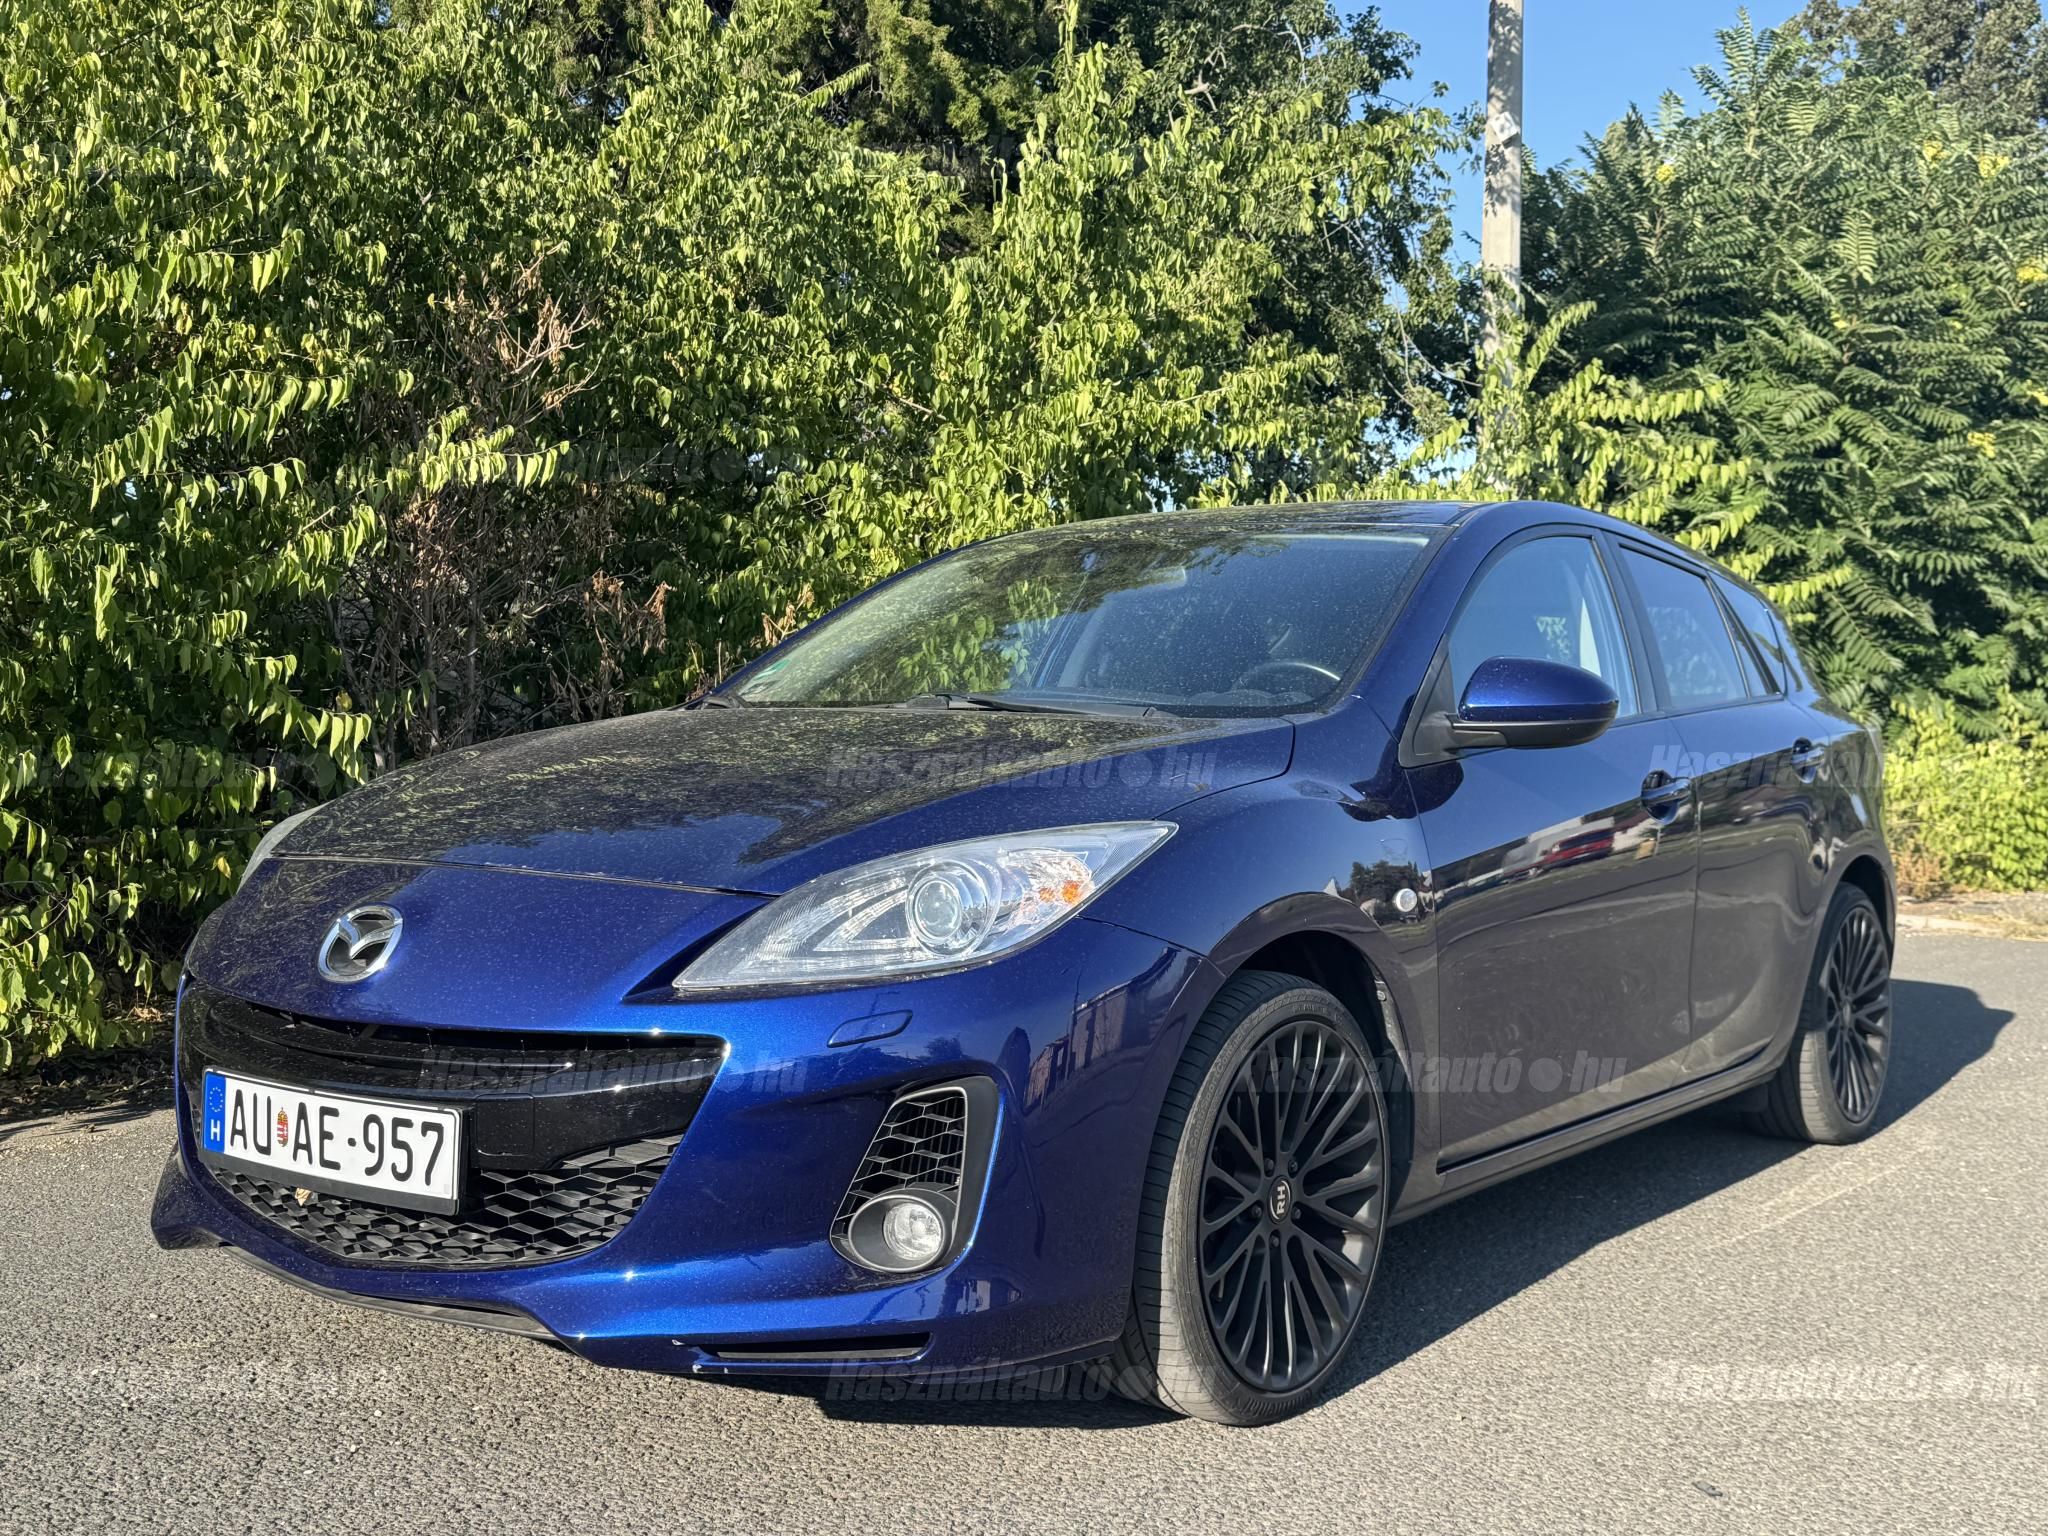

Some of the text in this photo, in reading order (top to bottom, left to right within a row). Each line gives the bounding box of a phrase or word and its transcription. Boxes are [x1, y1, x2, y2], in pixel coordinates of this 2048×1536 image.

[209, 1118, 221, 1142] H
[229, 1089, 272, 1156] AU
[1276, 1184, 1287, 1215] RH
